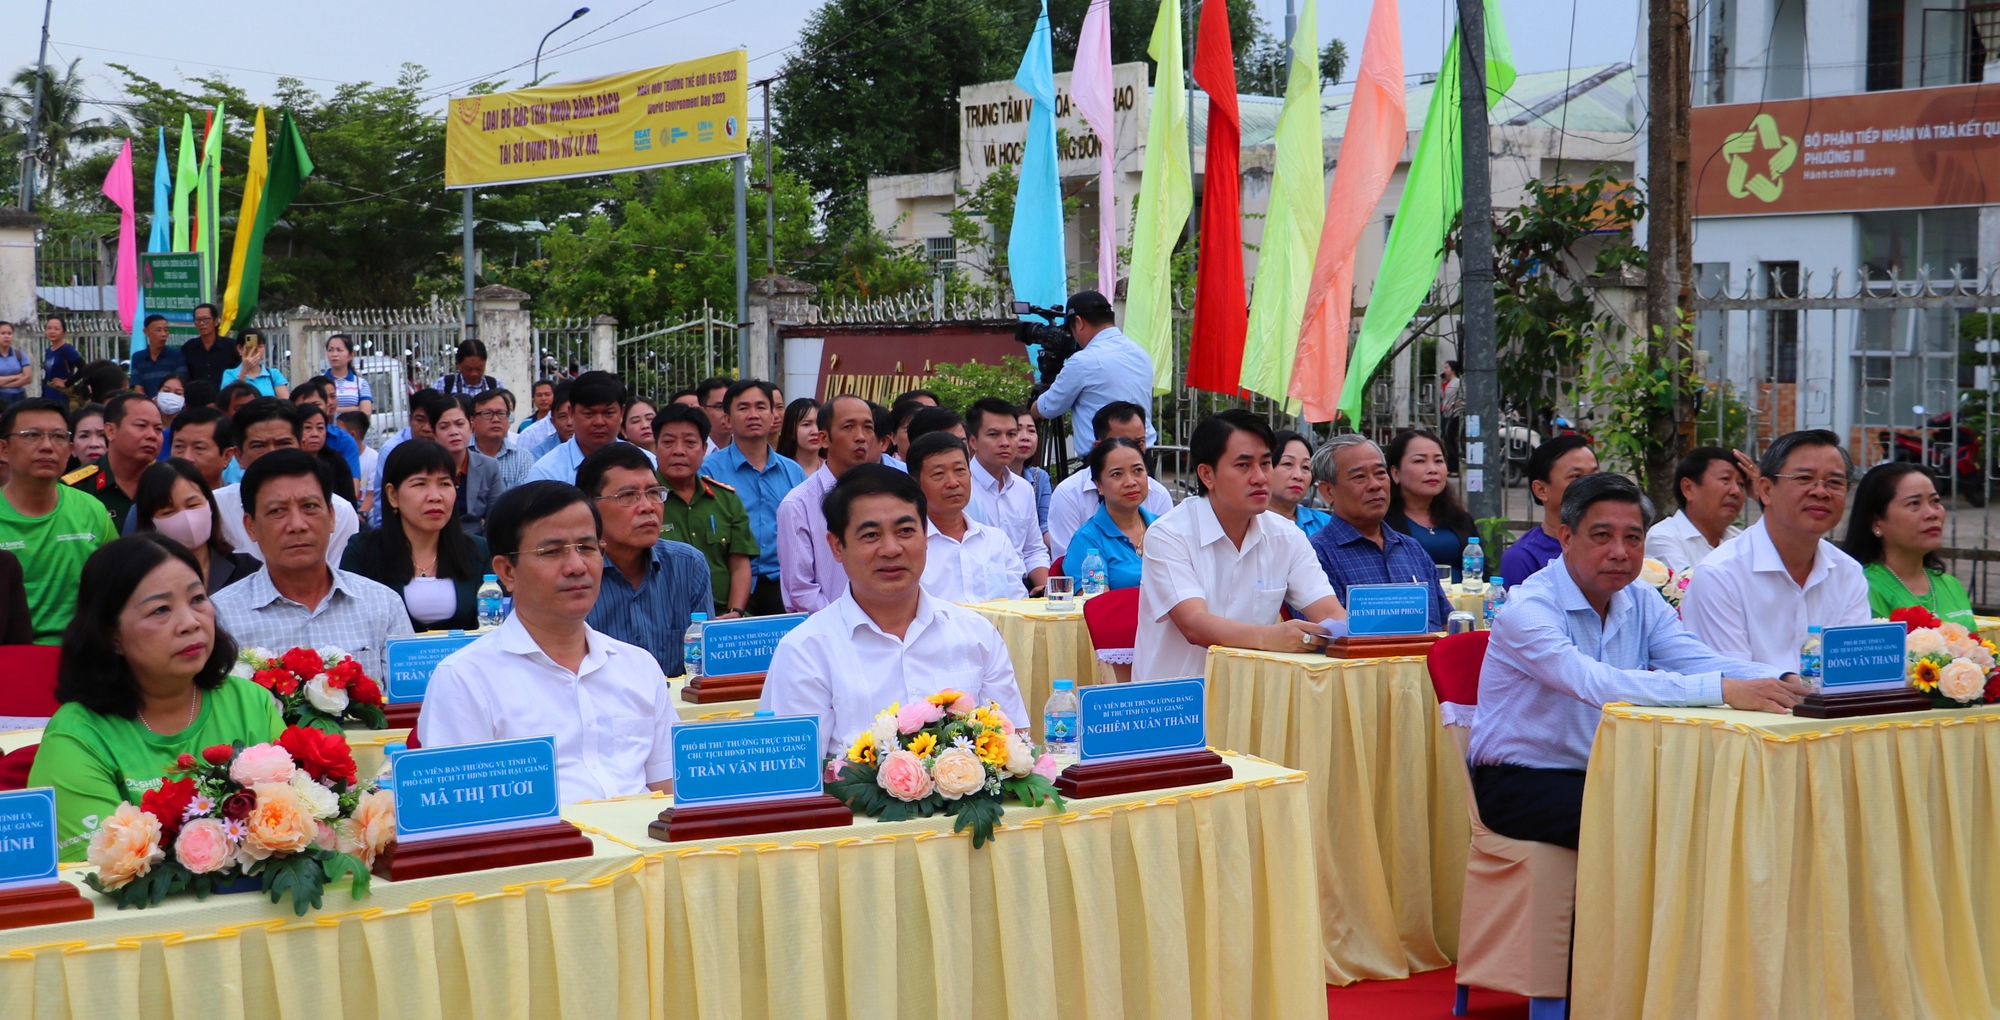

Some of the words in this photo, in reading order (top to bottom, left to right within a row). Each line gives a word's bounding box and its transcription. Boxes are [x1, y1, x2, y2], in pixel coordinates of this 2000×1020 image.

[664, 76, 684, 92] TRƯỜNG
[685, 72, 695, 88] THẾ
[648, 102, 664, 114] World
[665, 96, 700, 112] Environment
[700, 94, 710, 106] Day
[712, 92, 726, 104] 2023
[1113, 85, 1134, 112] HAO
[482, 110, 498, 134] LOẠI
[501, 102, 511, 129] BỎ
[513, 103, 529, 127] RÁC
[530, 98, 548, 125] THẢI
[550, 98, 571, 126] NHỰA
[597, 90, 620, 116] CÁCH
[965, 102, 999, 128] TRUNG
[1001, 96, 1023, 124] TÂM
[634, 128, 651, 139] BEAT
[1804, 132, 1821, 150] BỘ
[1823, 130, 1854, 148] PHẬN
[1856, 126, 1880, 144] TIẾP
[1882, 126, 1915, 144] NHẬN
[1916, 124, 1932, 140] VÀ
[1932, 121, 1956, 138] TRẢ
[1958, 118, 1982, 137] KẾT
[500, 140, 511, 165] TÁI
[526, 140, 547, 166] DỤNG
[549, 134, 560, 159] VÀ
[575, 130, 585, 156] LÝ
[984, 138, 997, 167] VÀ
[1804, 150, 1850, 165] PHƯỜNG
[1853, 150, 1865, 162] III
[1804, 168, 1828, 180] Hành
[1829, 166, 1856, 179] chính
[1857, 166, 1881, 179] phục
[1883, 167, 1896, 178] vụ
[1352, 608, 1375, 616] HUỲNH
[710, 648, 752, 660] NGUYỄN
[1828, 656, 1851, 668] ĐỒNG
[1853, 654, 1870, 666] VĂN
[1871, 654, 1900, 665] THANH
[395, 669, 426, 681] TRẦN
[1094, 702, 1103, 711] ỦY
[1104, 700, 1119, 710] VIÊN
[1120, 700, 1134, 708] BCH
[1135, 698, 1156, 707] TRUNG
[1157, 696, 1176, 705] ƯƠNG
[1176, 694, 1194, 703] ĐẢNG
[1103, 708, 1110, 718] BÍ
[1110, 708, 1125, 717] THƯ
[1126, 706, 1140, 716] TỈNH
[1141, 705, 1150, 714] ỦY
[1151, 705, 1164, 714] HẬU
[1164, 704, 1184, 712] GIANG
[1087, 720, 1130, 734] NGHIÊM
[1133, 716, 1161, 731] XUÂN
[1163, 712, 1199, 726] THÀNH
[682, 741, 698, 751] PHÓ
[699, 740, 707, 750] BÍ
[708, 740, 726, 749] THƯ
[726, 736, 759, 748] THƯỜNG
[760, 736, 781, 746] TRỰC
[782, 734, 801, 743] TỈNH
[802, 732, 812, 742] ỦY
[687, 750, 704, 760] CHỦ
[705, 749, 723, 759] TỊCH
[724, 748, 746, 757] HĐND
[746, 745, 765, 755] TỈNH
[766, 744, 782, 755] HẬU
[782, 743, 806, 752] GIANG
[402, 777, 418, 787] PHÓ
[419, 775, 436, 785] CHỦ
[437, 774, 455, 784] TỊCH
[456, 772, 466, 782] TT
[467, 770, 488, 780] HĐND
[489, 767, 507, 778] TỈNH
[508, 766, 524, 776] HẬU
[525, 764, 549, 774] GIANG
[413, 767, 423, 777] ỦY
[425, 766, 444, 776] VIÊN
[445, 764, 461, 774] BAN
[462, 760, 495, 772] THƯỜNG
[495, 760, 507, 769] VỤ
[508, 756, 527, 766] TỈNH
[527, 756, 538, 764] ỦY
[688, 762, 726, 778] TRẦN
[728, 758, 757, 774] VĂN
[760, 755, 807, 772] HUYẾN
[139, 778, 164, 788] SHIN
[420, 787, 450, 807] MÃ
[453, 784, 485, 804] THỊ
[489, 780, 534, 799] TƯƠI
[0, 812, 19, 822] TỈNH
[21, 812, 33, 820] ỦY
[15, 820, 44, 830] GIANG
